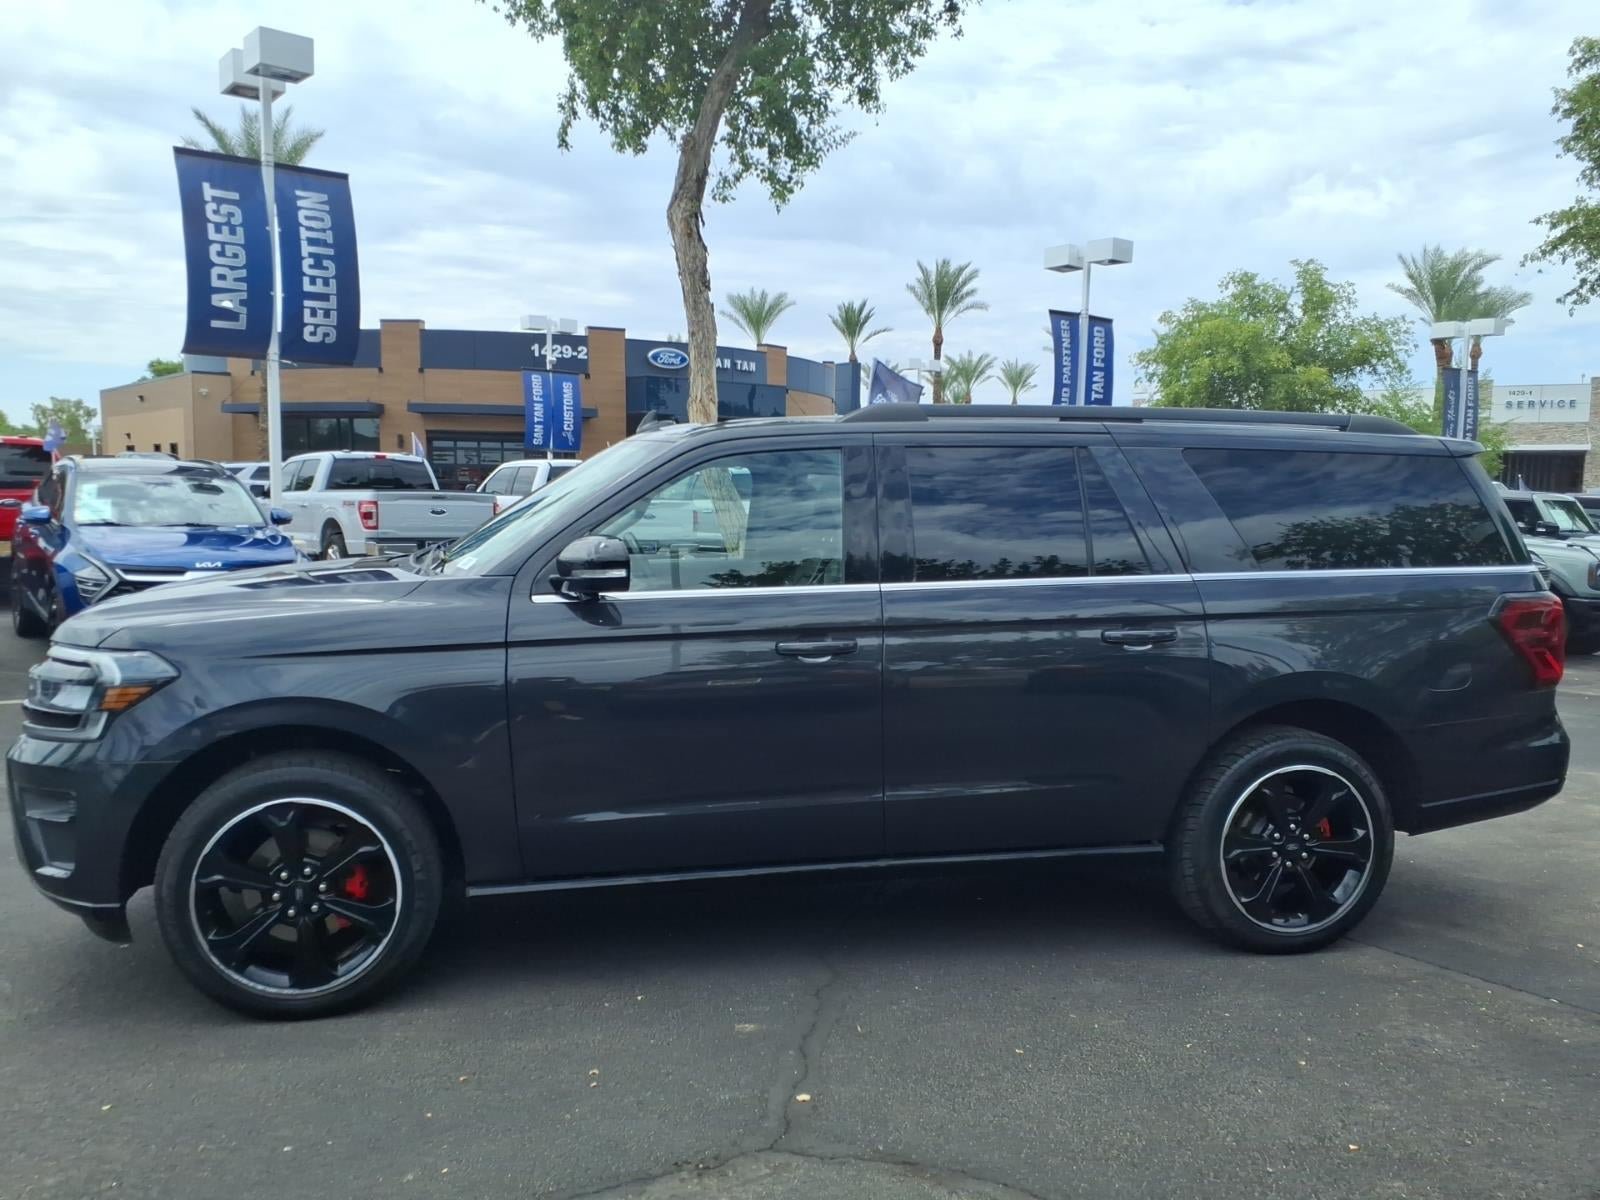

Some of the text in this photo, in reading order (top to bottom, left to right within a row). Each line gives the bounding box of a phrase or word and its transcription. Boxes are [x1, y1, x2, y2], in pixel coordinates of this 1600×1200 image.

[202, 181, 247, 330] LARGEST
[294, 189, 337, 344] SELECTION
[716, 358, 756, 372] AN TAN
[1060, 319, 1071, 384] PARTNER
[1091, 326, 1106, 401] TAN FORD
[531, 374, 544, 446] SAN TAN FORD
[562, 381, 575, 431] CUSTOMS
[1466, 409, 1474, 431] TAN
[1467, 377, 1475, 407] FORD
[1505, 399, 1577, 409] SERVICE
